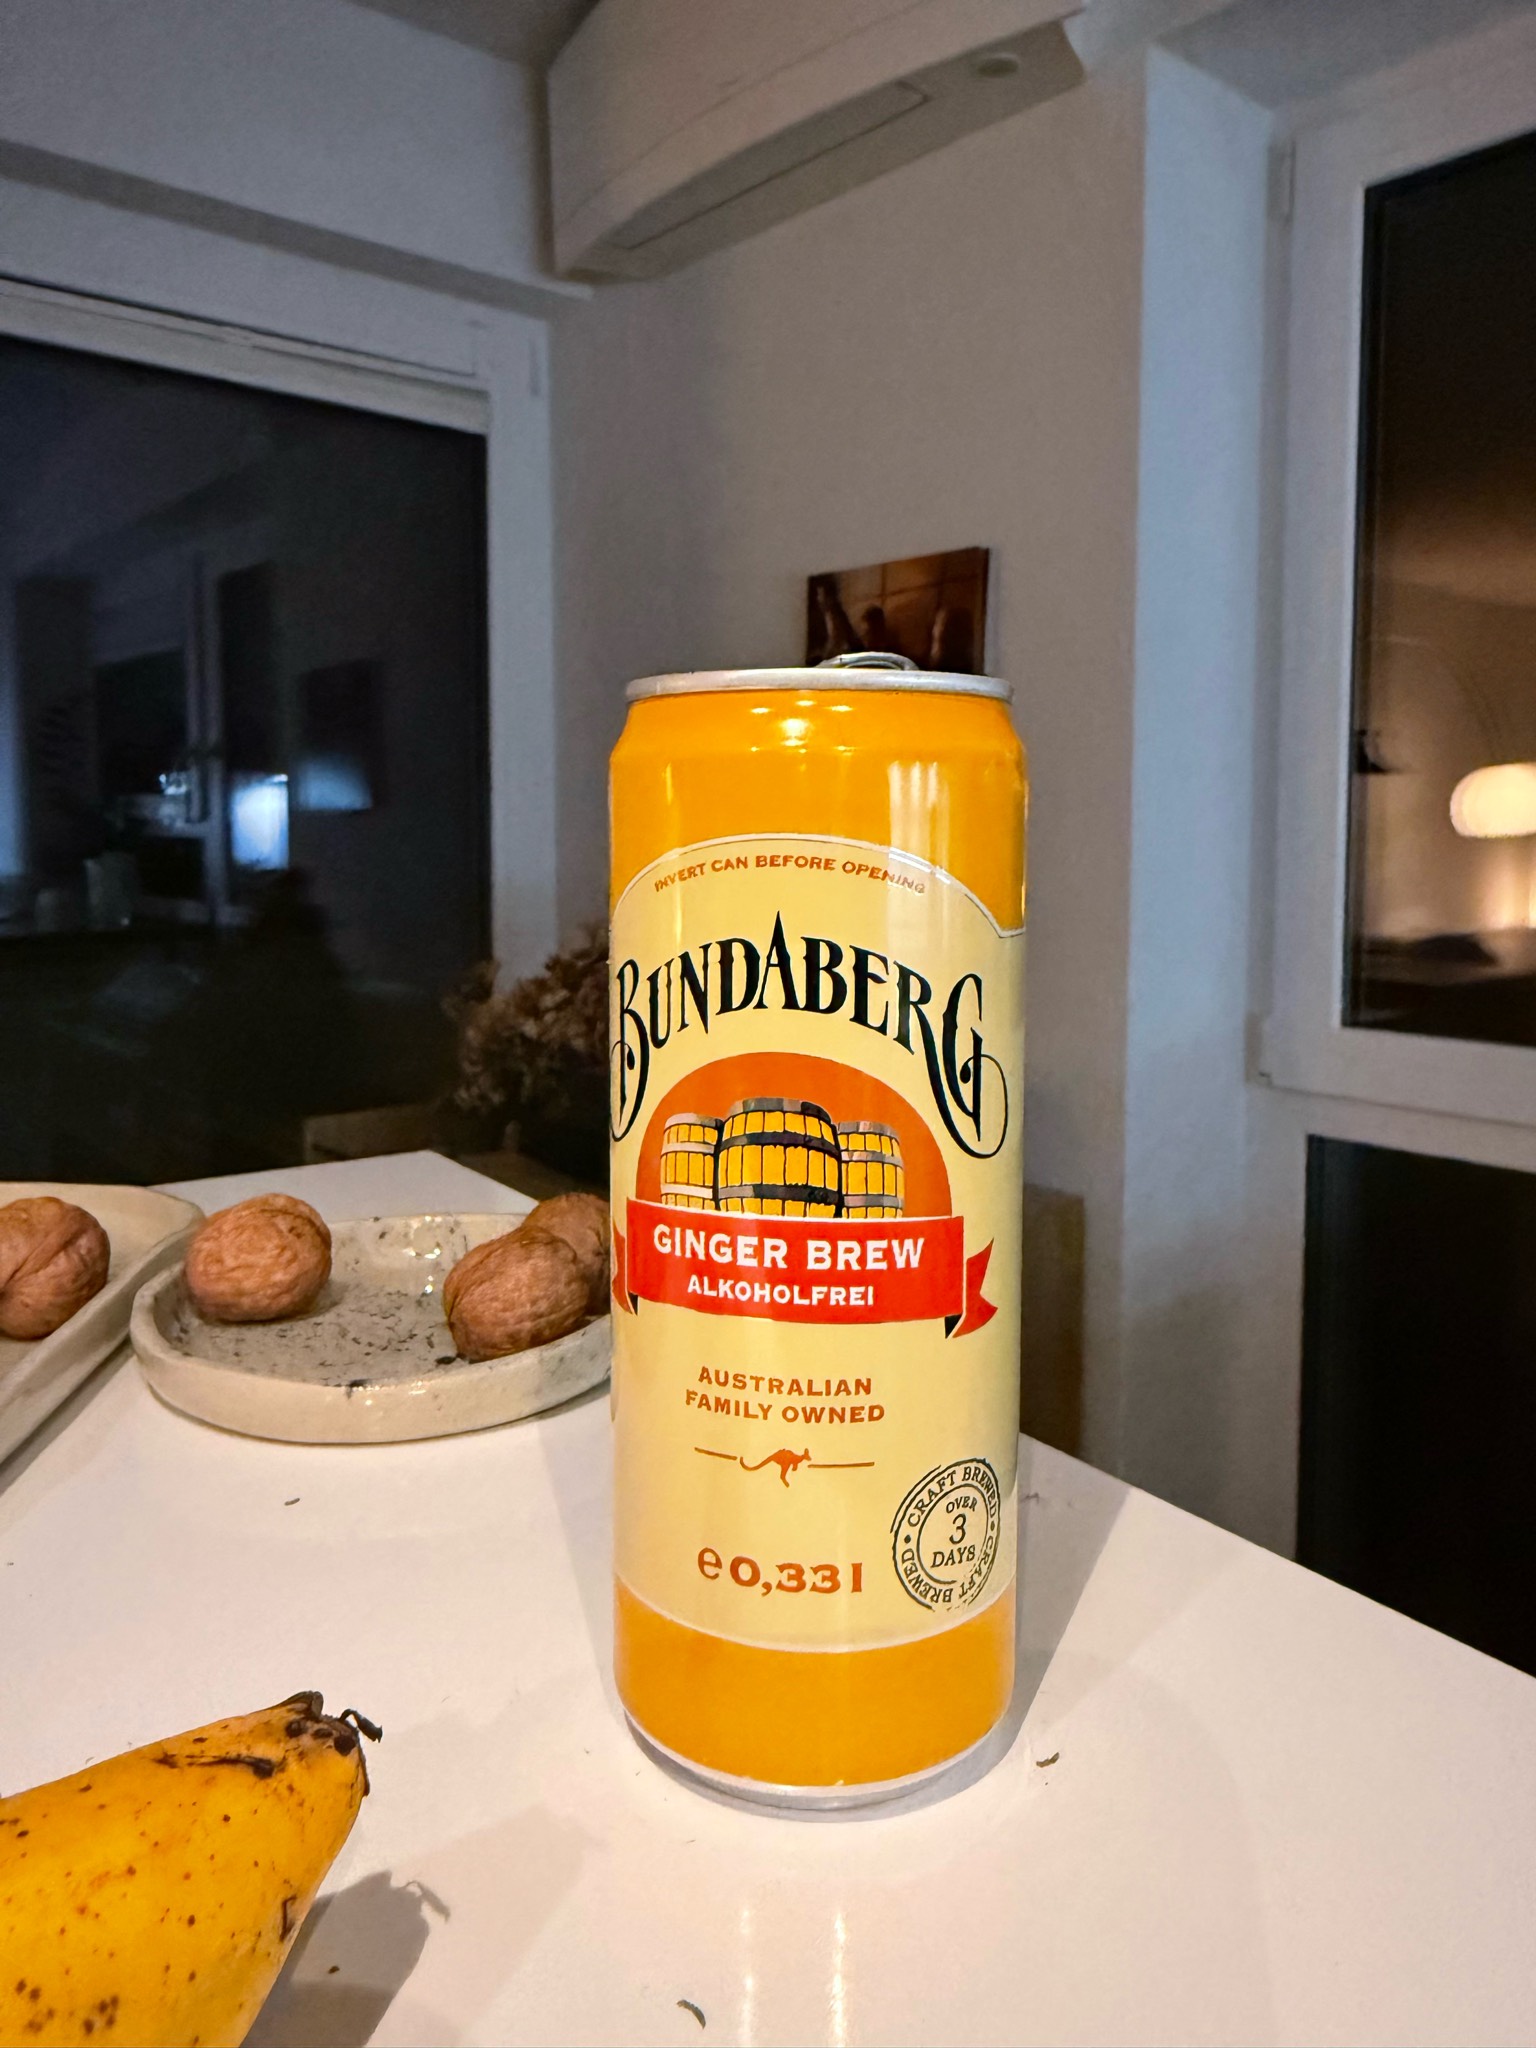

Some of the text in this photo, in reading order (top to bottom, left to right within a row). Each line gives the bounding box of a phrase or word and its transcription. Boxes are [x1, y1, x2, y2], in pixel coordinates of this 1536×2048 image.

[654, 854, 926, 894] INVERT CAN BEFORE OPENING
[611, 911, 1008, 1158] BUNDABERG
[653, 1223, 925, 1271] GINGER BREW
[687, 1274, 875, 1306] ALKOHOLFREI
[698, 1366, 872, 1397] AUSTRALIAN
[685, 1389, 885, 1424] FAMILY OWNED
[907, 1466, 997, 1527] CRAFT BREWED
[945, 1496, 978, 1514] OVER
[949, 1513, 967, 1545] 3
[930, 1545, 976, 1568] DAYS
